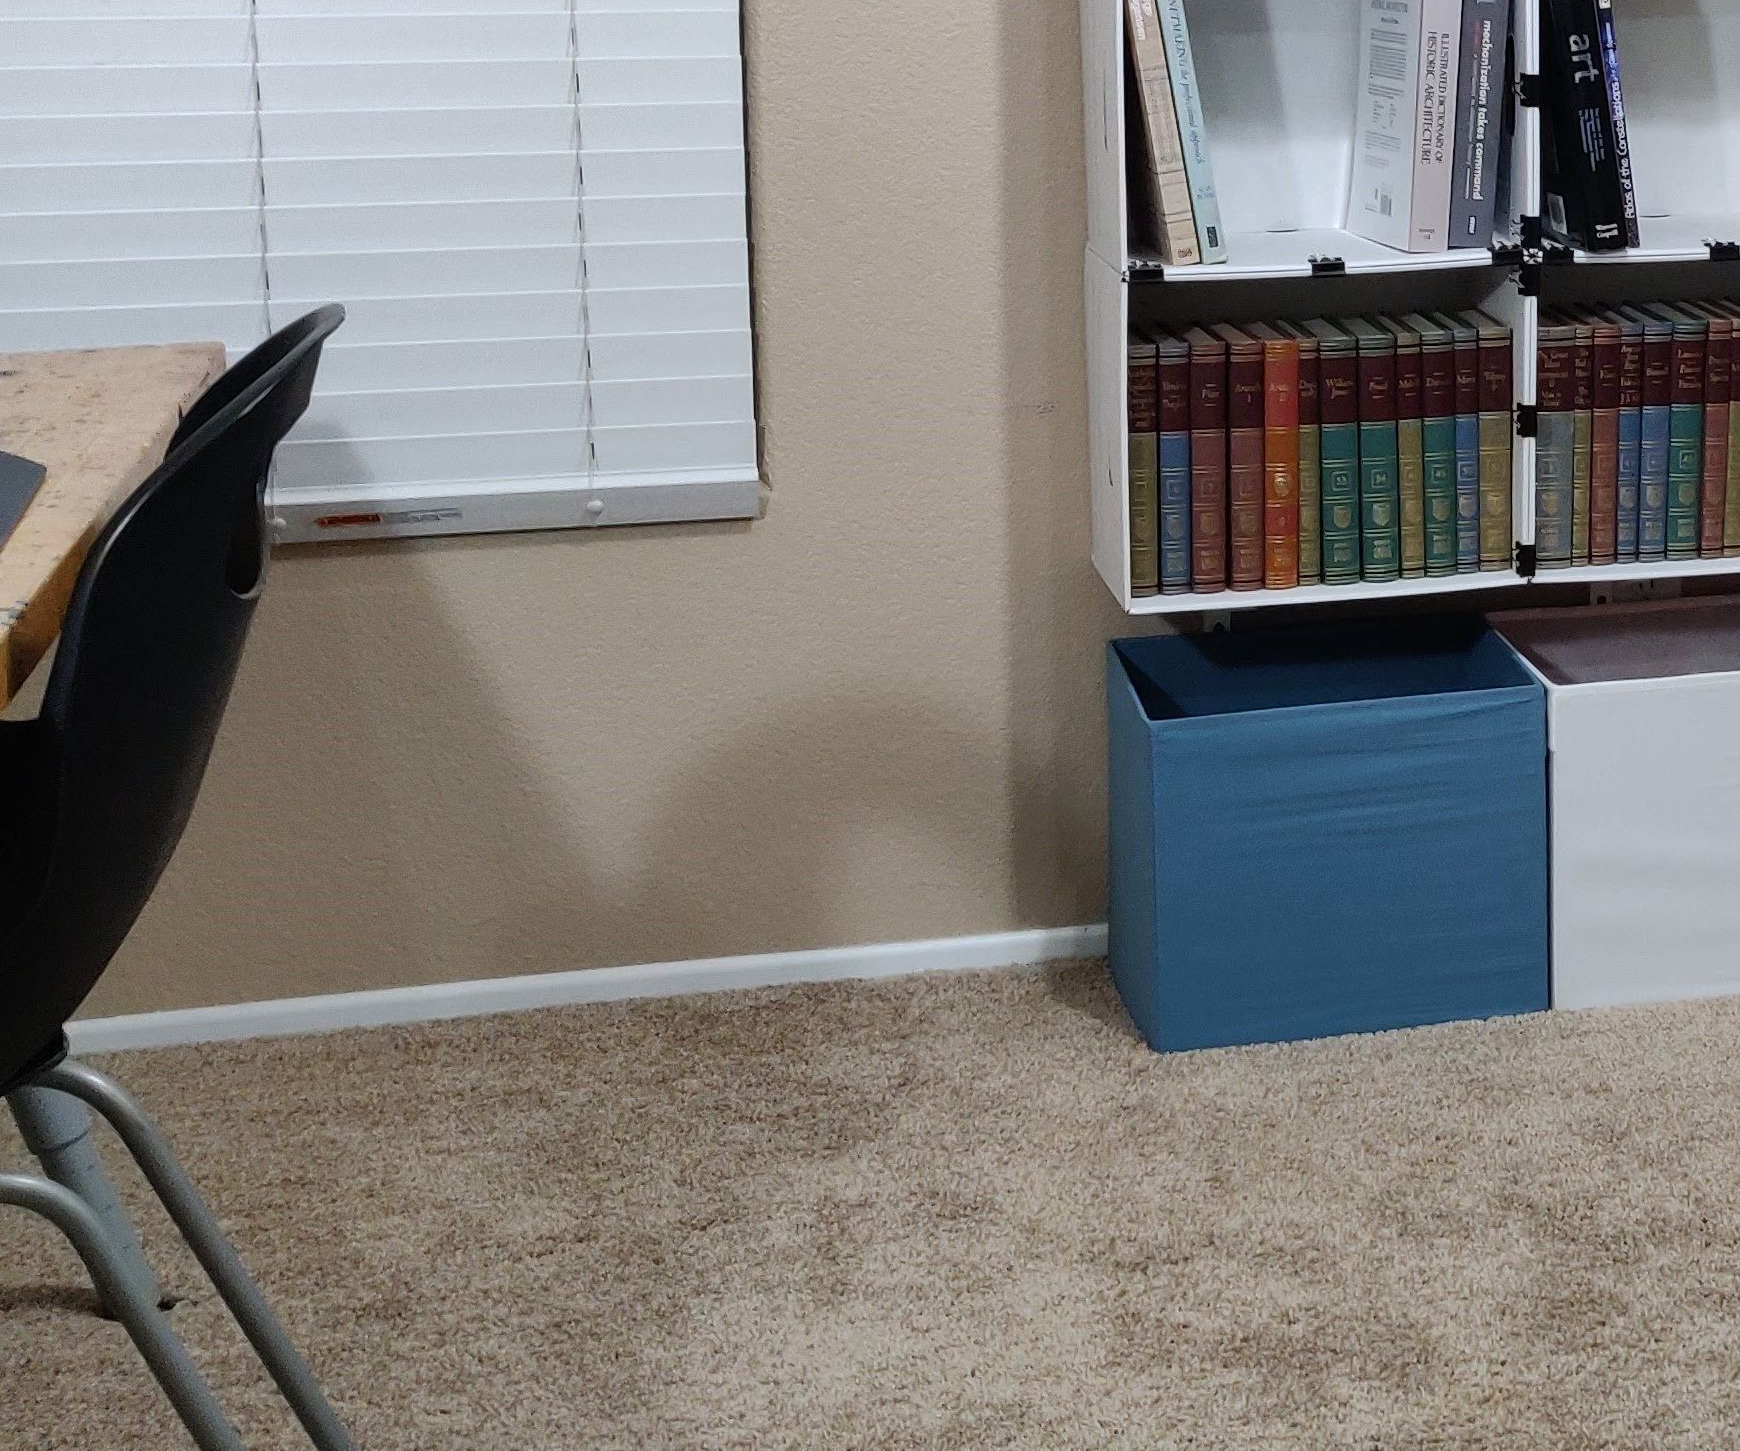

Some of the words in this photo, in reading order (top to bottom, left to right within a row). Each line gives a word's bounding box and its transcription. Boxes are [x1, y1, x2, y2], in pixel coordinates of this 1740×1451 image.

[1425, 30, 1436, 79] HISTORIC
[1437, 32, 1449, 93] ILLUSTRATED
[1477, 20, 1494, 104] mechanization
[1569, 32, 1599, 83] art
[1420, 83, 1433, 165] ARCHITECTURE
[1434, 95, 1446, 149] DICTIONARY
[1475, 106, 1488, 139] takes
[1434, 151, 1443, 163] OF
[1471, 142, 1486, 199] command
[1618, 157, 1630, 177] the
